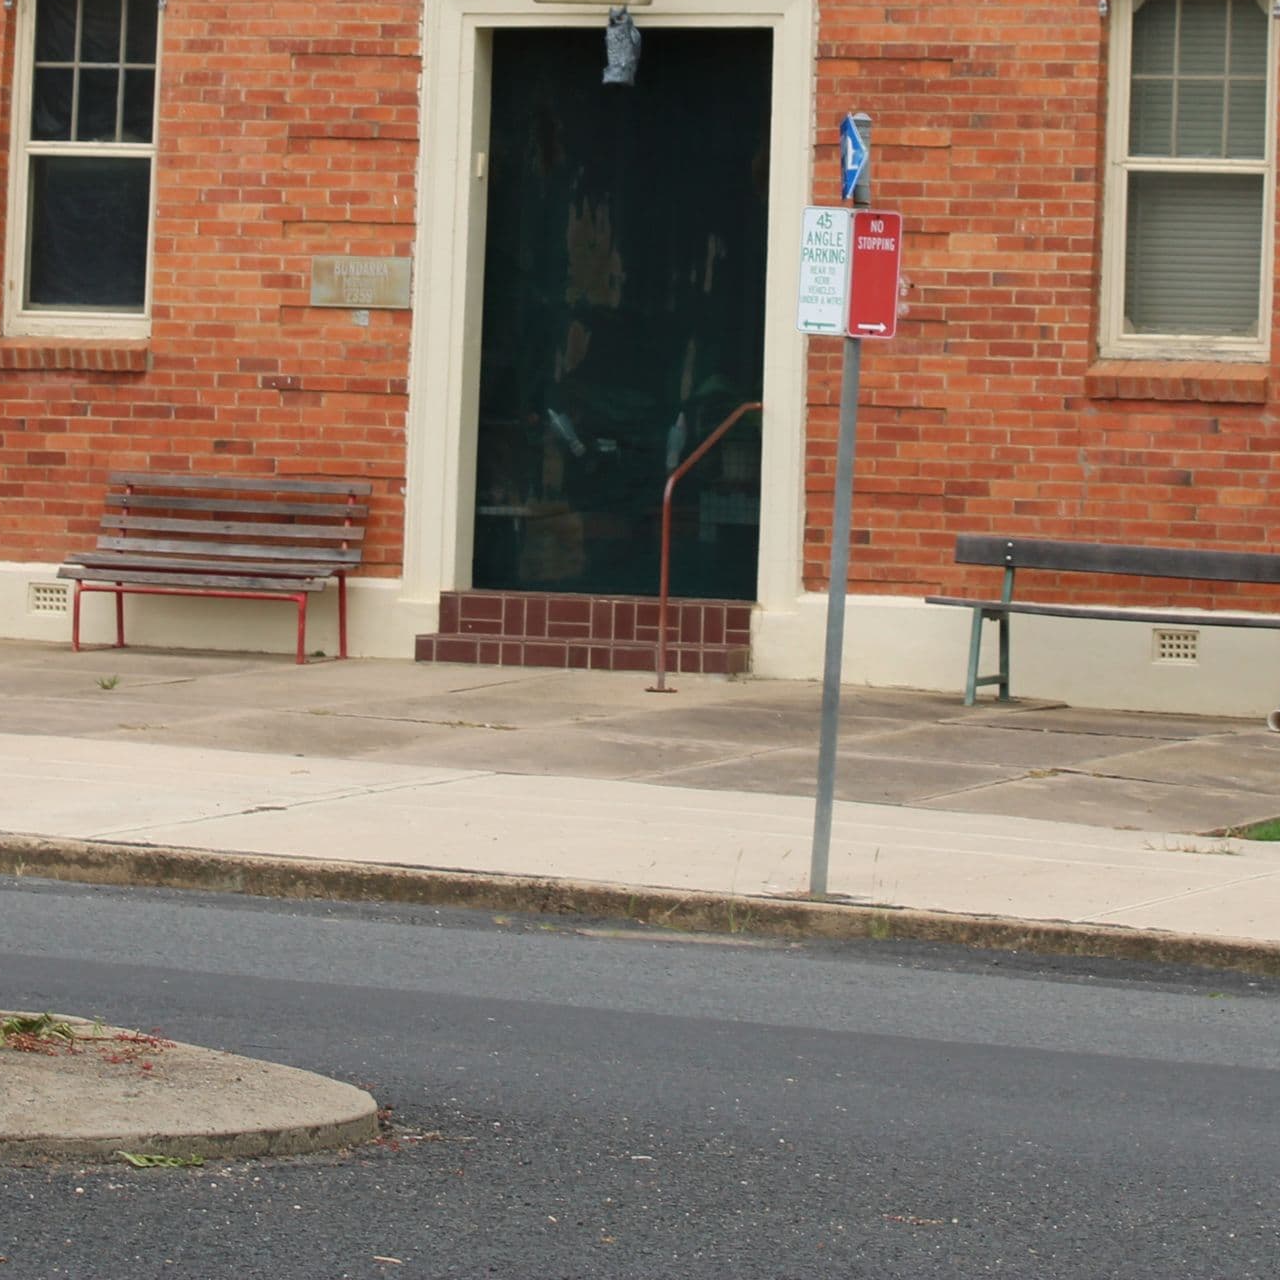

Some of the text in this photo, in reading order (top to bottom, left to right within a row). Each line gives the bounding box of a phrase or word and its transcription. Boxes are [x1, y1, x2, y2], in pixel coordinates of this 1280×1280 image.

[871, 220, 884, 233] NO
[807, 231, 843, 247] ANGLE
[858, 236, 895, 251] STOPPING
[803, 248, 846, 264] PARKING
